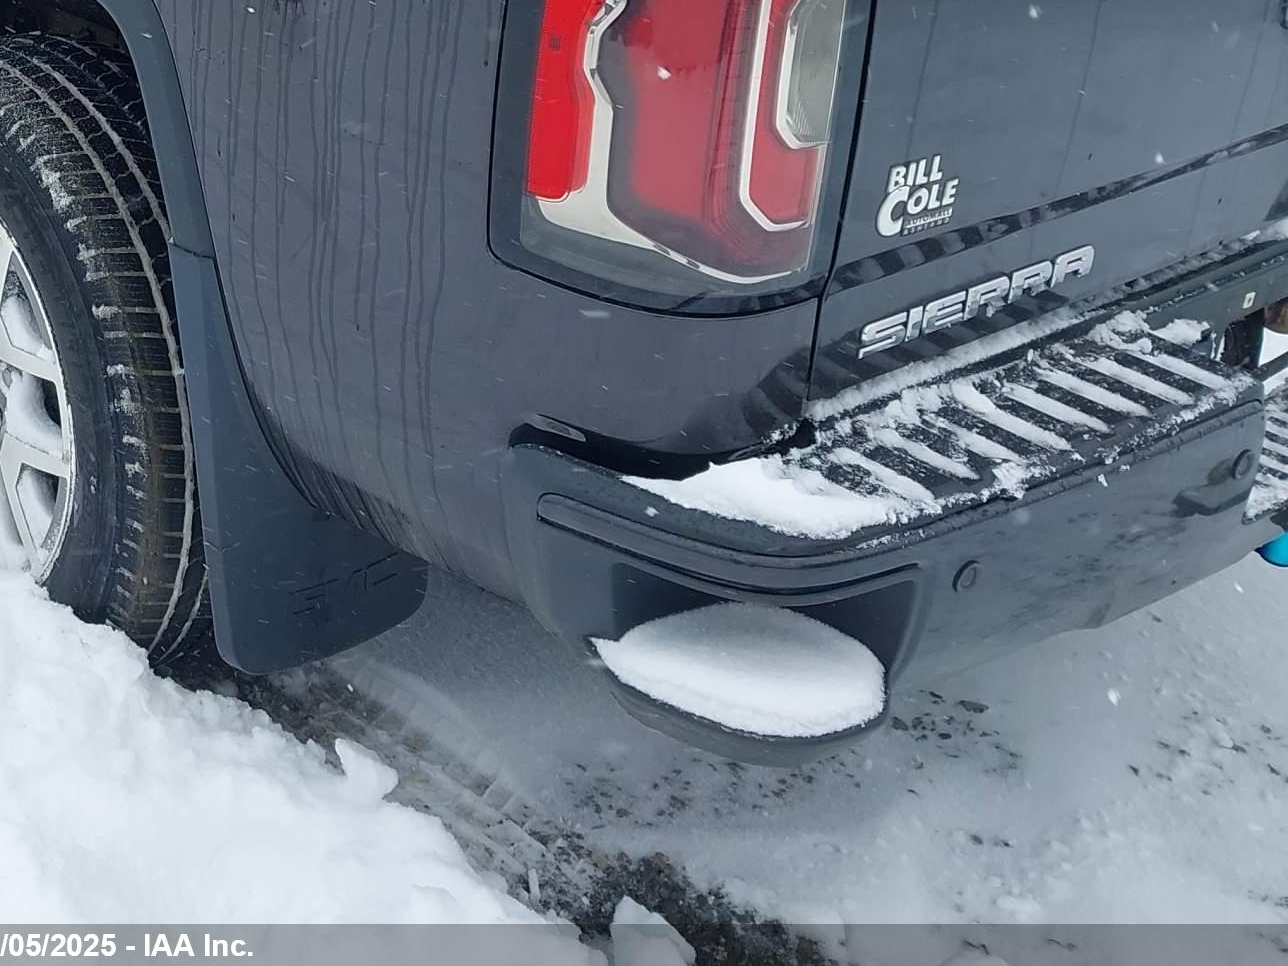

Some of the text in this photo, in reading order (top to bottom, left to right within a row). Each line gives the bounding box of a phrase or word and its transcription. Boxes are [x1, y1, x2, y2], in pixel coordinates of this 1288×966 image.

[887, 155, 943, 193] BILL
[877, 177, 959, 236] COLE
[857, 245, 1095, 359] SIERRA
